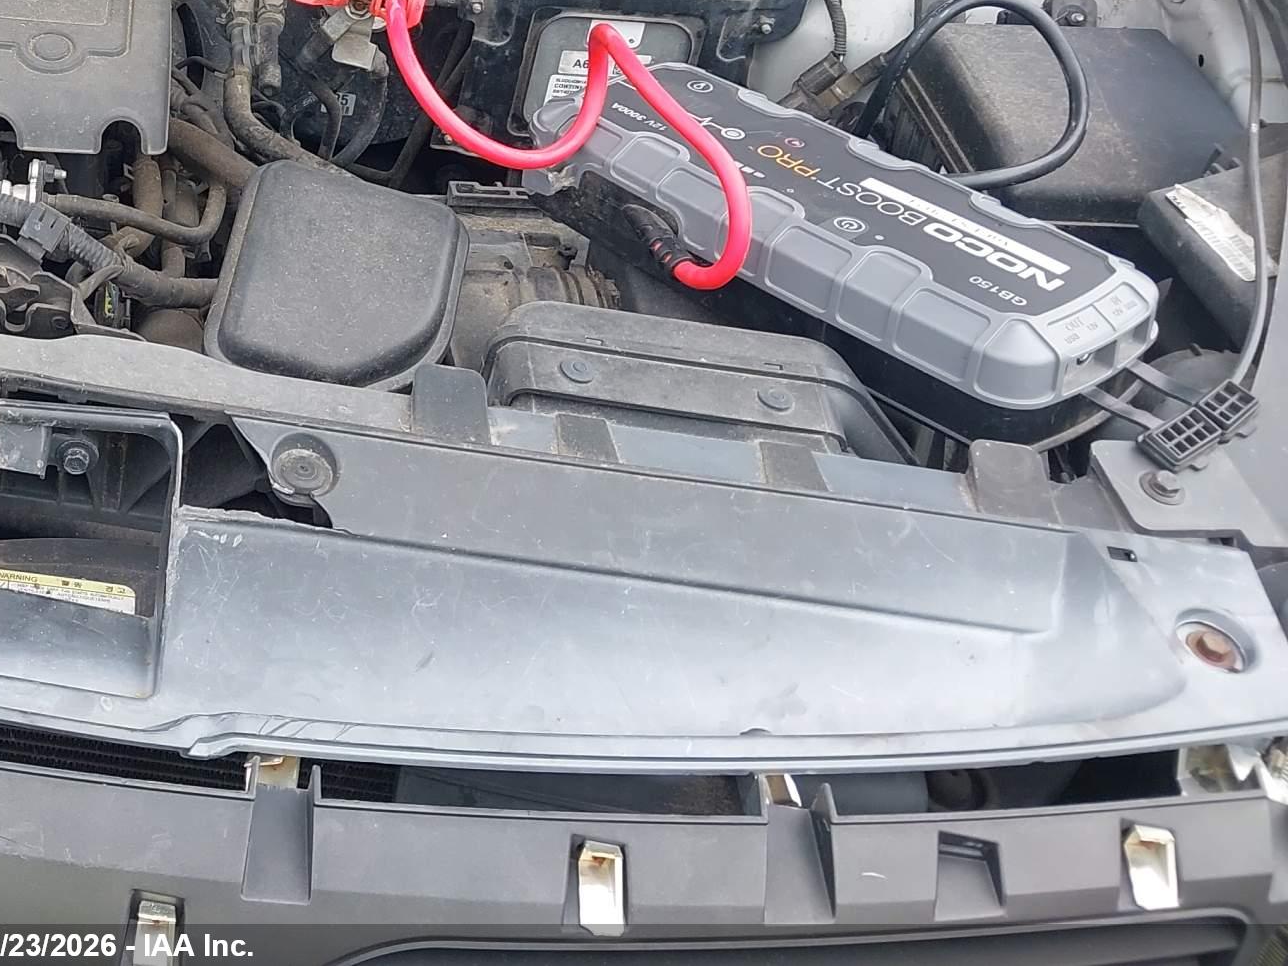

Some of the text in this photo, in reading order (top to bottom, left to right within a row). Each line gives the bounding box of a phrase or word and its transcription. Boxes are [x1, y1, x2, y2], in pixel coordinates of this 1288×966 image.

[612, 102, 668, 131] 12V 3000A
[757, 145, 821, 178] PRO
[817, 177, 927, 226] BOOST
[923, 222, 1065, 291] NOCO
[969, 276, 1027, 306] GB150
